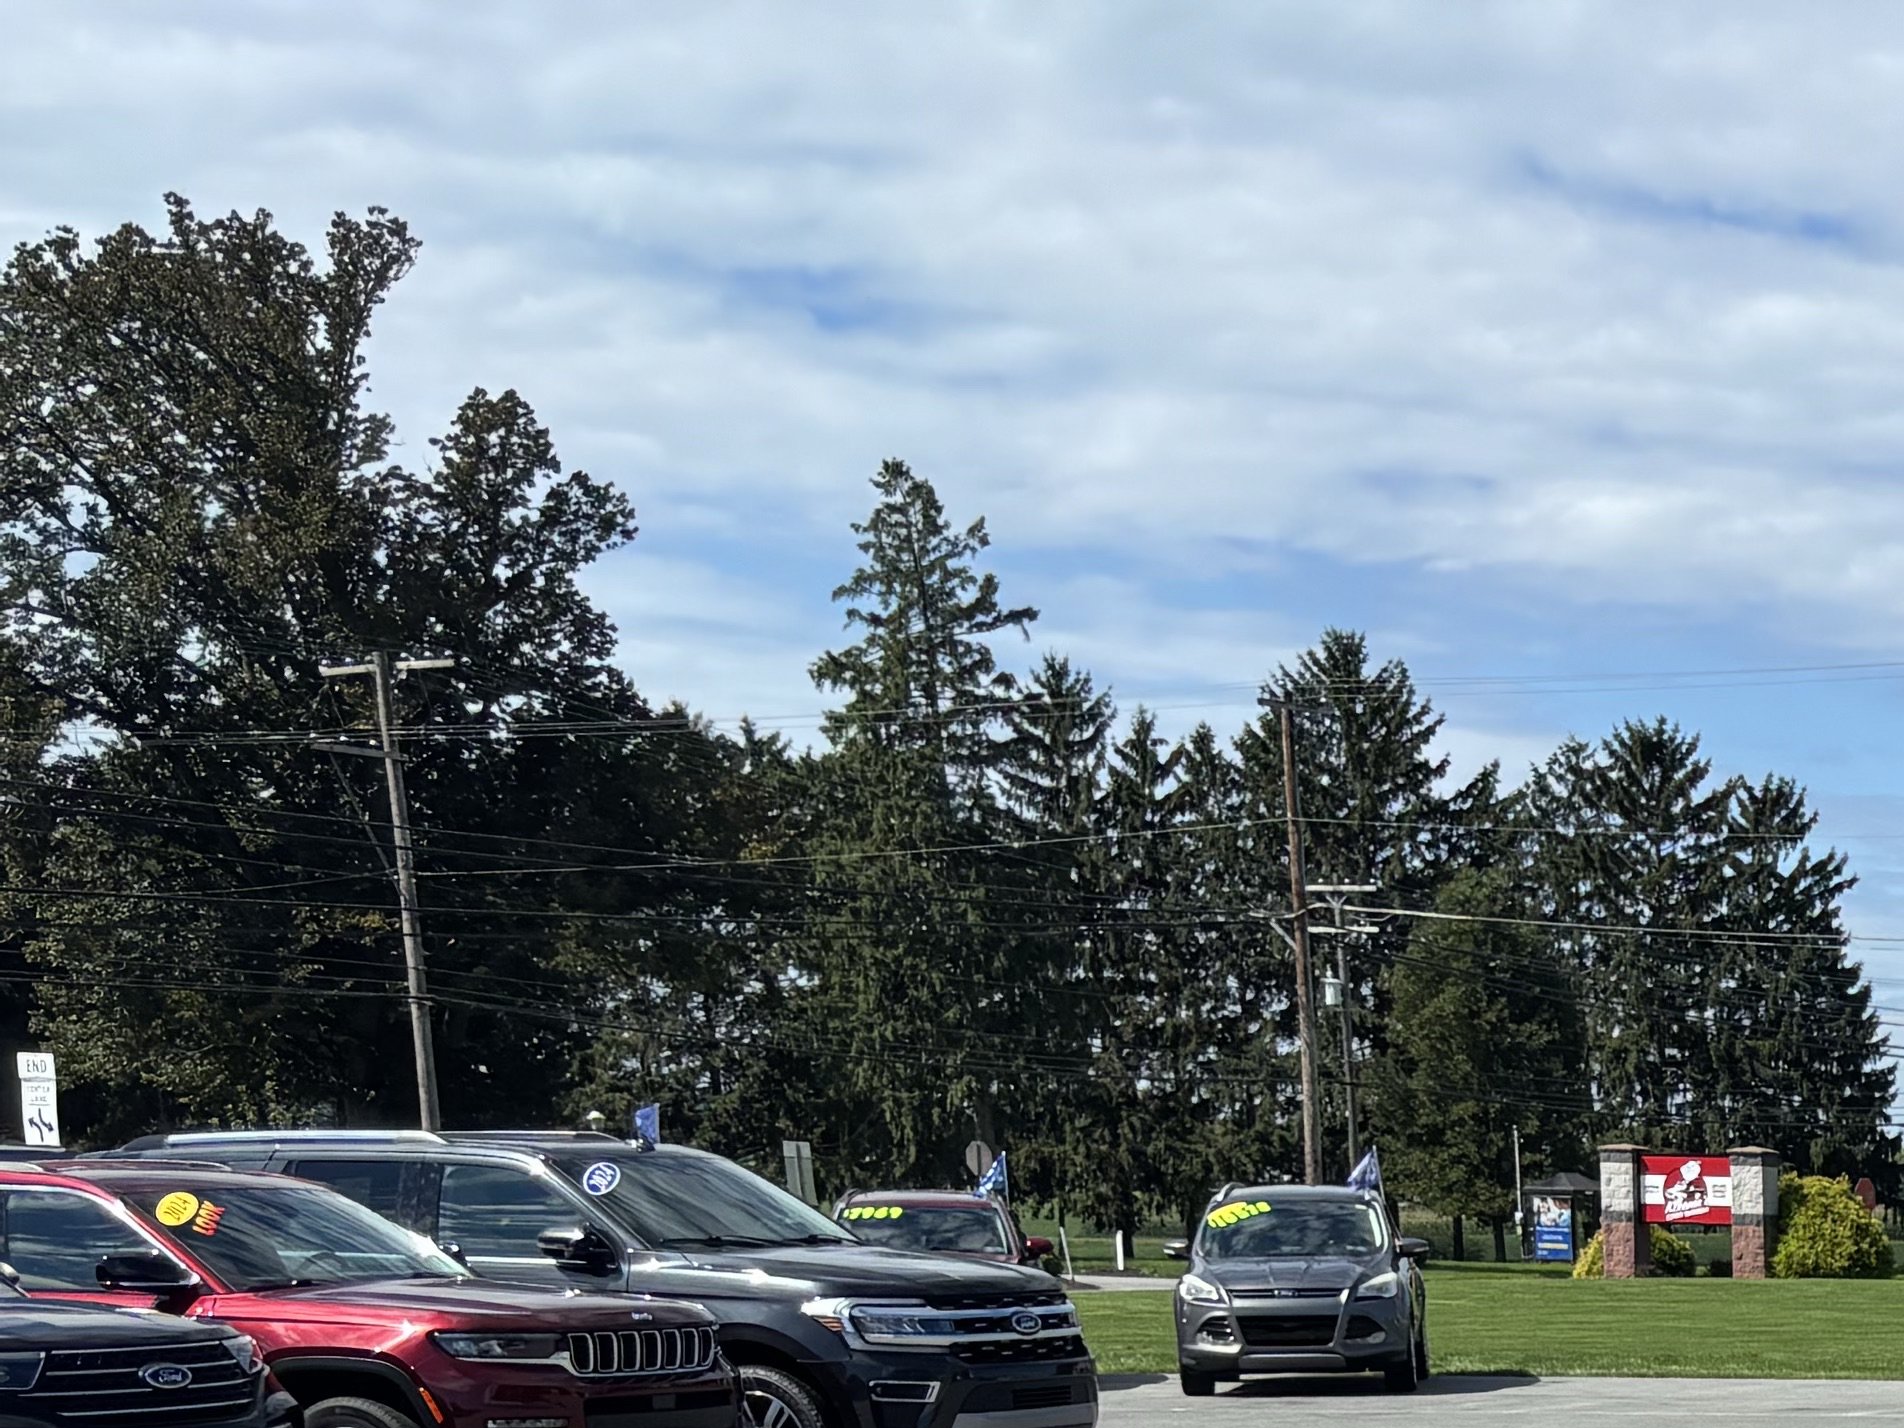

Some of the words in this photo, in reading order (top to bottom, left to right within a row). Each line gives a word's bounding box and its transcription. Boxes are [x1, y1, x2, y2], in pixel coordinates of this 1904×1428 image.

[26, 1059, 47, 1073] END
[588, 1164, 615, 1192] 2024
[163, 1195, 191, 1221] 2024
[192, 1200, 225, 1236] LOOK
